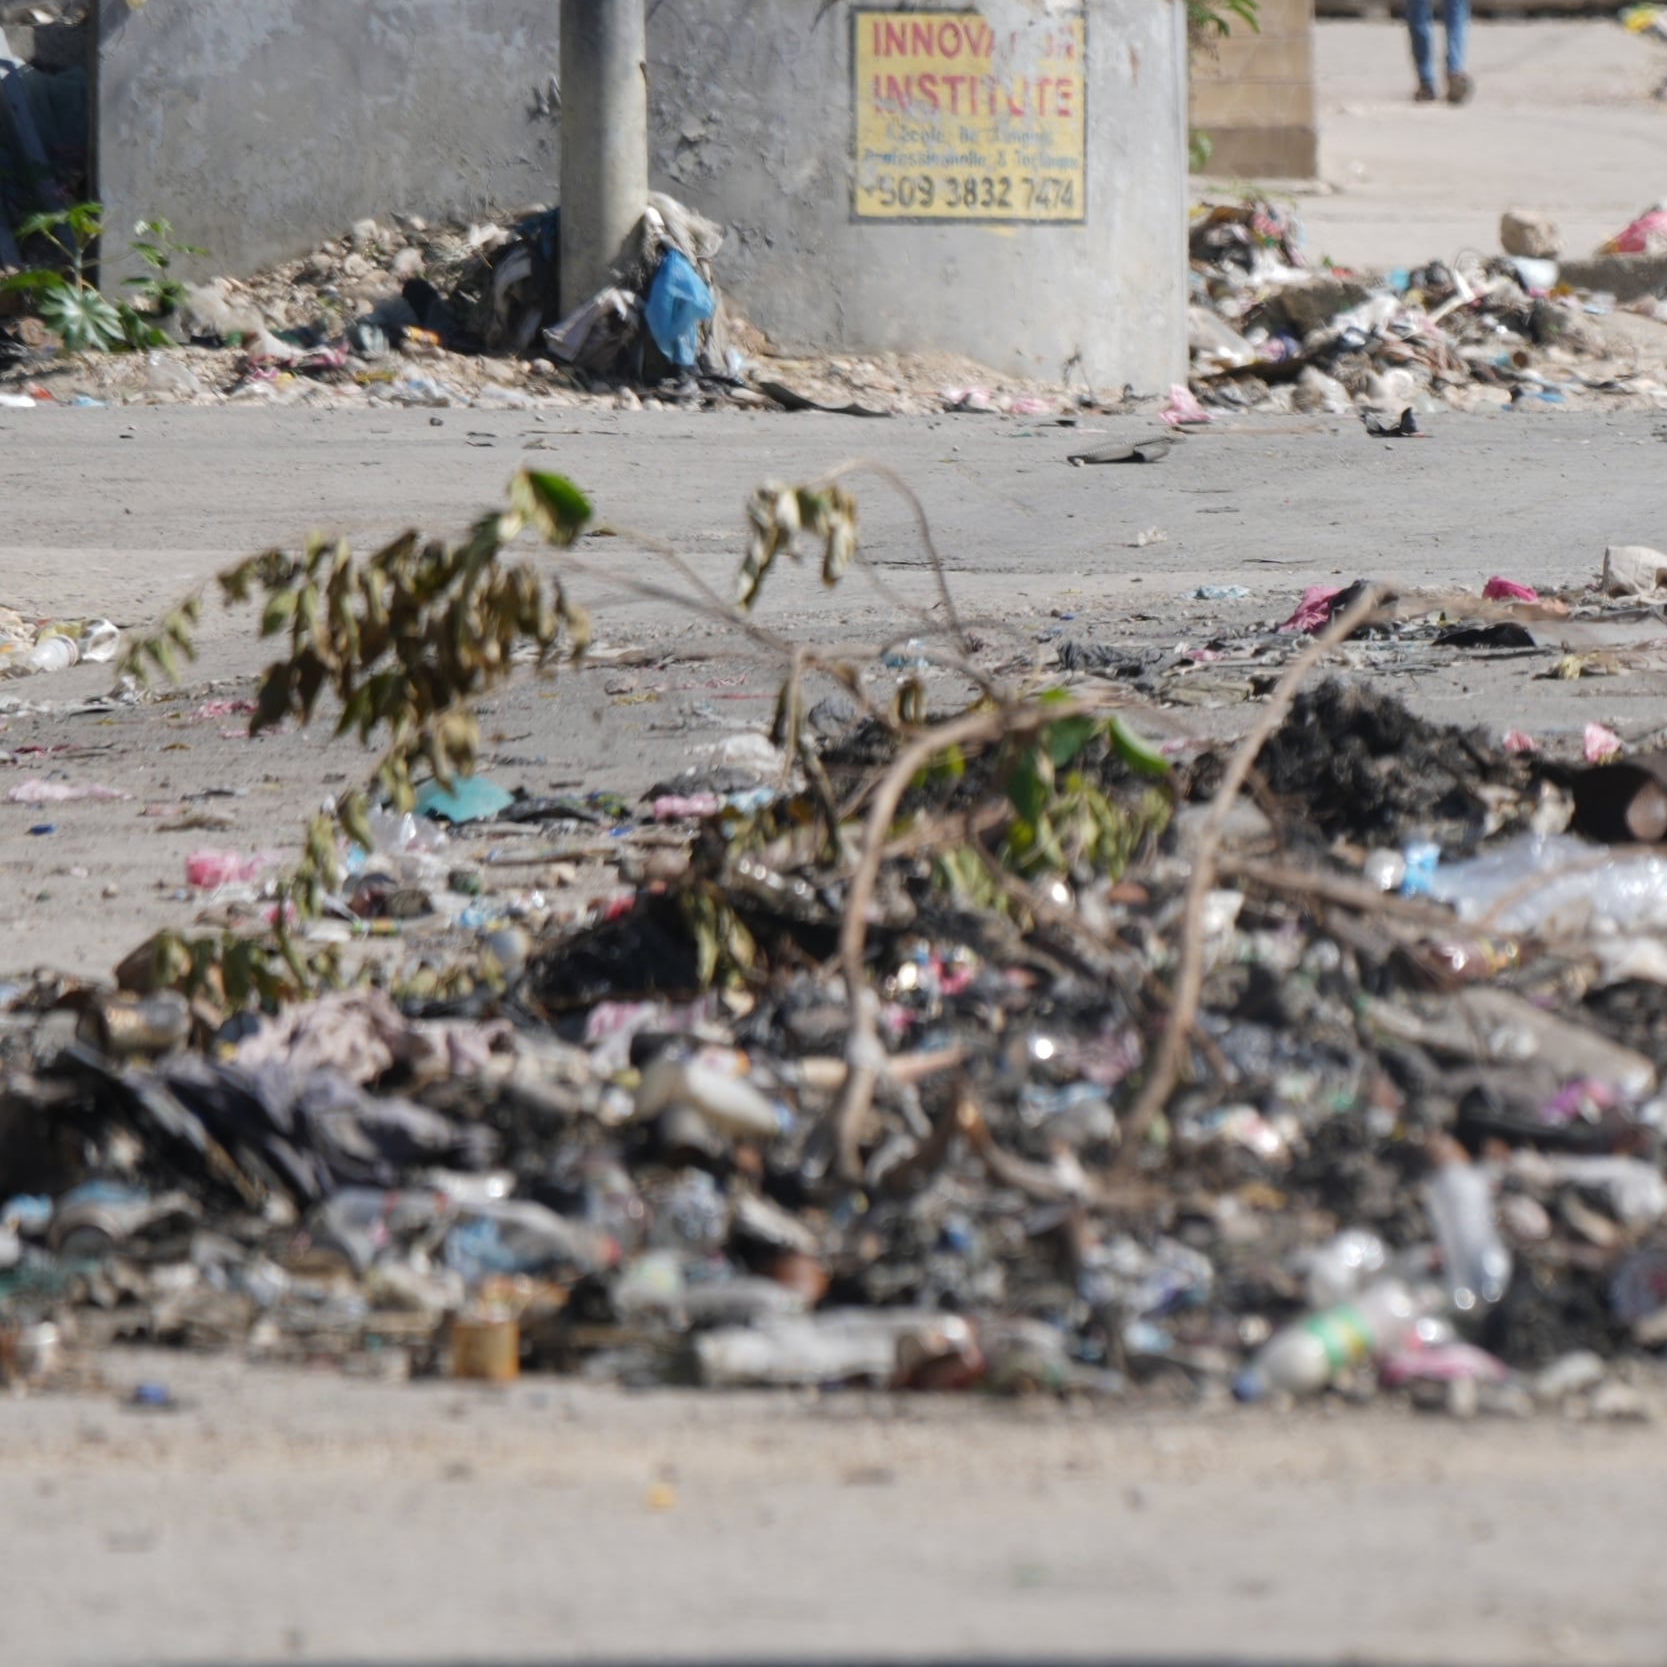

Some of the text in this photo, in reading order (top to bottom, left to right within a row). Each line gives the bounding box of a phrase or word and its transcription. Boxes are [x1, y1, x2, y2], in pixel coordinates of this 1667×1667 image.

[873, 20, 1075, 61] INNOVN
[873, 73, 1073, 117] INSTITUTE
[946, 176, 1012, 209] 3832
